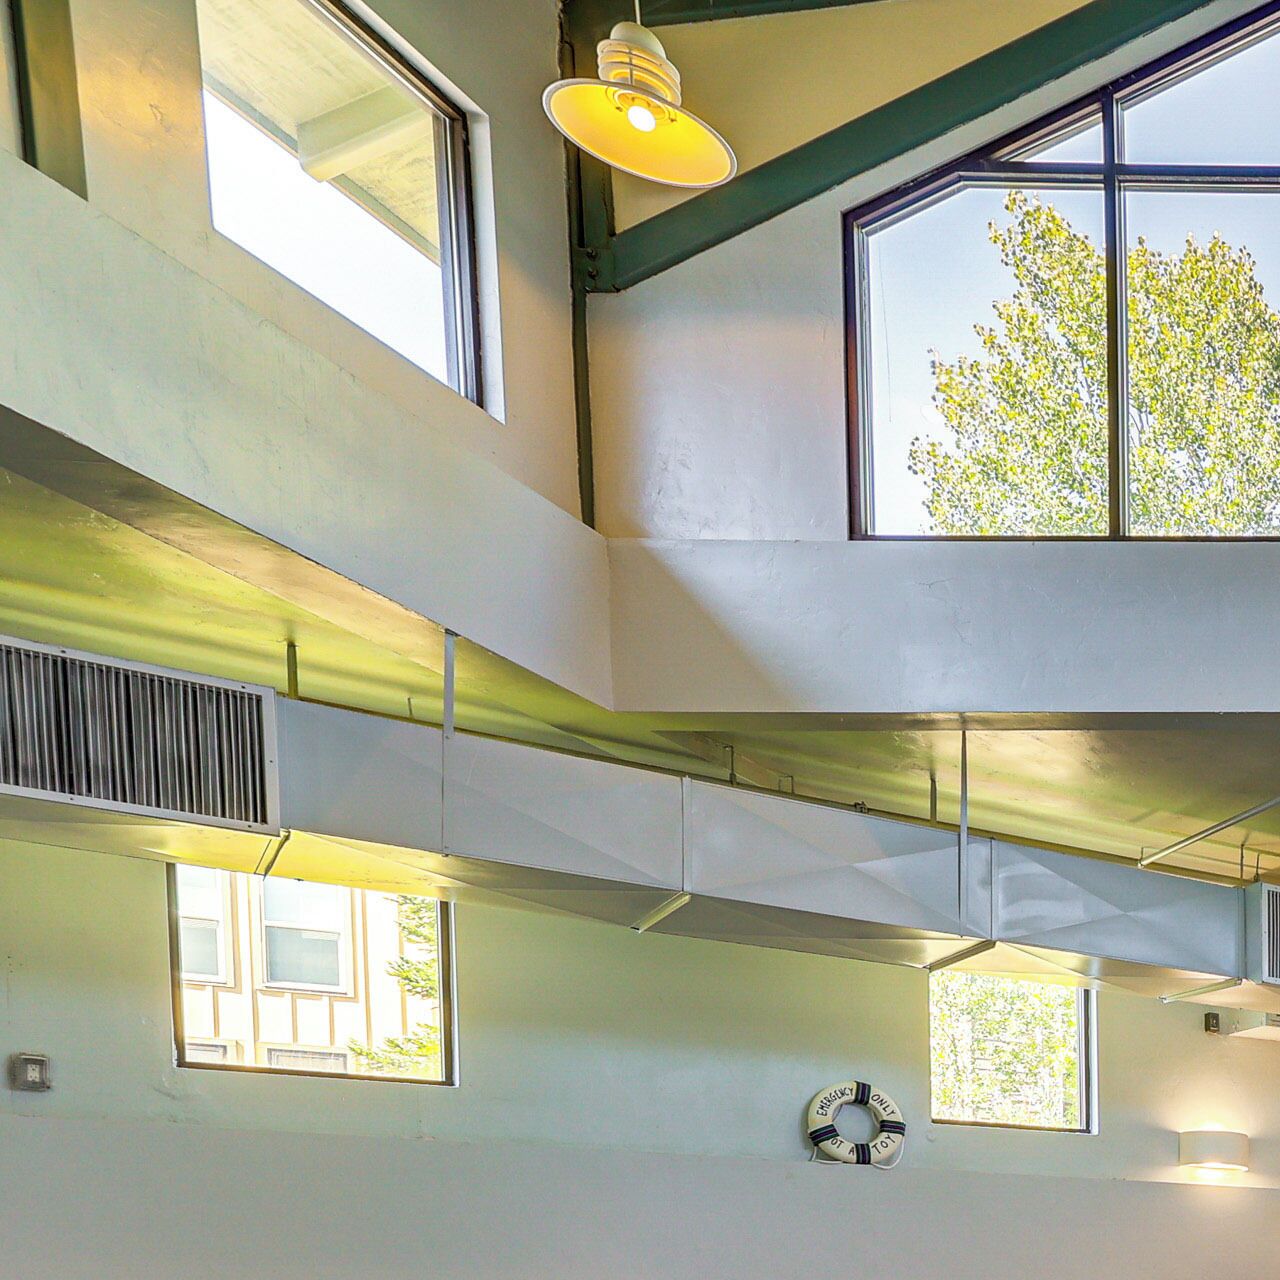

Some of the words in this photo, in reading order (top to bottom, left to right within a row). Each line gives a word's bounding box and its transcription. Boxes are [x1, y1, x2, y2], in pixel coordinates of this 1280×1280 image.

[816, 1087, 854, 1116] EMERGENCY
[870, 1093, 896, 1117] ONLY
[848, 1147, 855, 1156] A
[871, 1133, 896, 1154] TOY
